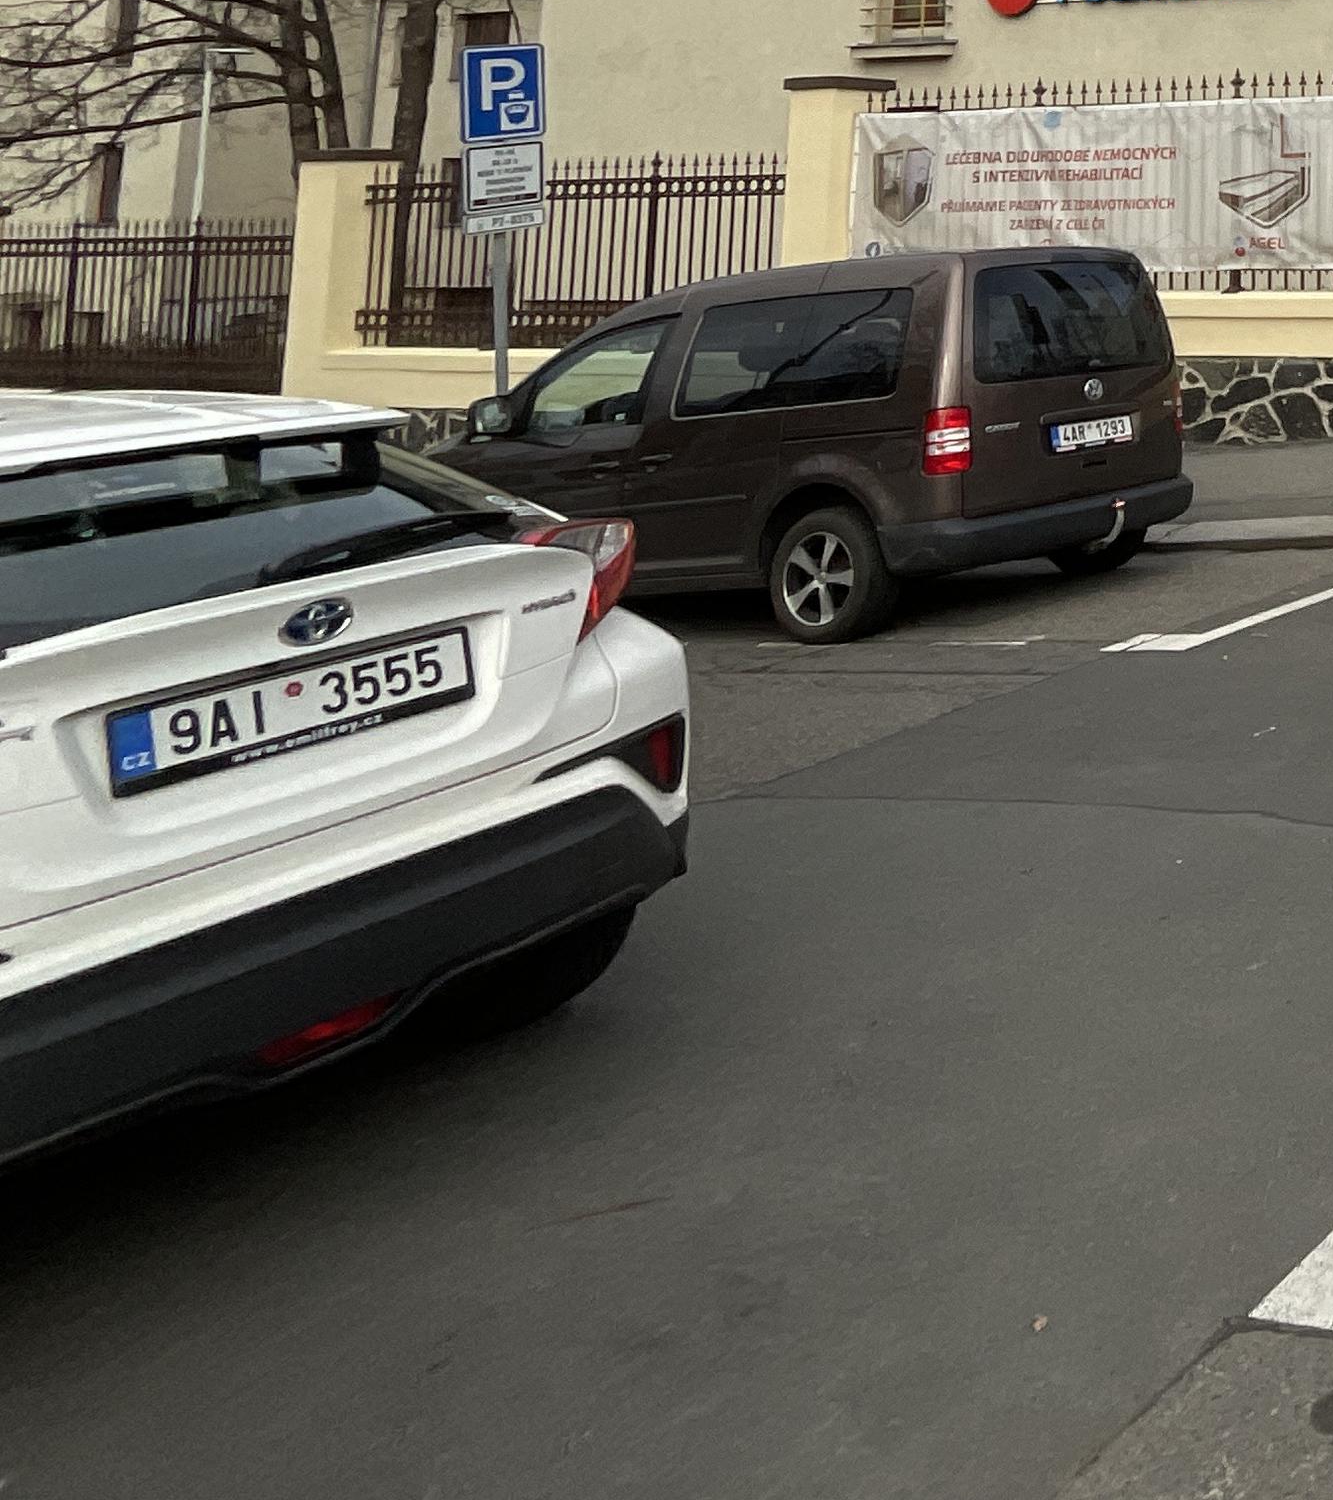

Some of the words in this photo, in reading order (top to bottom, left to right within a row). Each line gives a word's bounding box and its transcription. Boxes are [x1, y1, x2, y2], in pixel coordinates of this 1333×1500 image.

[480, 58, 526, 111] P
[1249, 237, 1286, 249] AGEL
[1063, 426, 1087, 443] 4AR
[1097, 419, 1126, 438] 1293
[121, 751, 151, 772] CZ
[168, 690, 266, 755] 9AI
[319, 645, 443, 714] 3555
